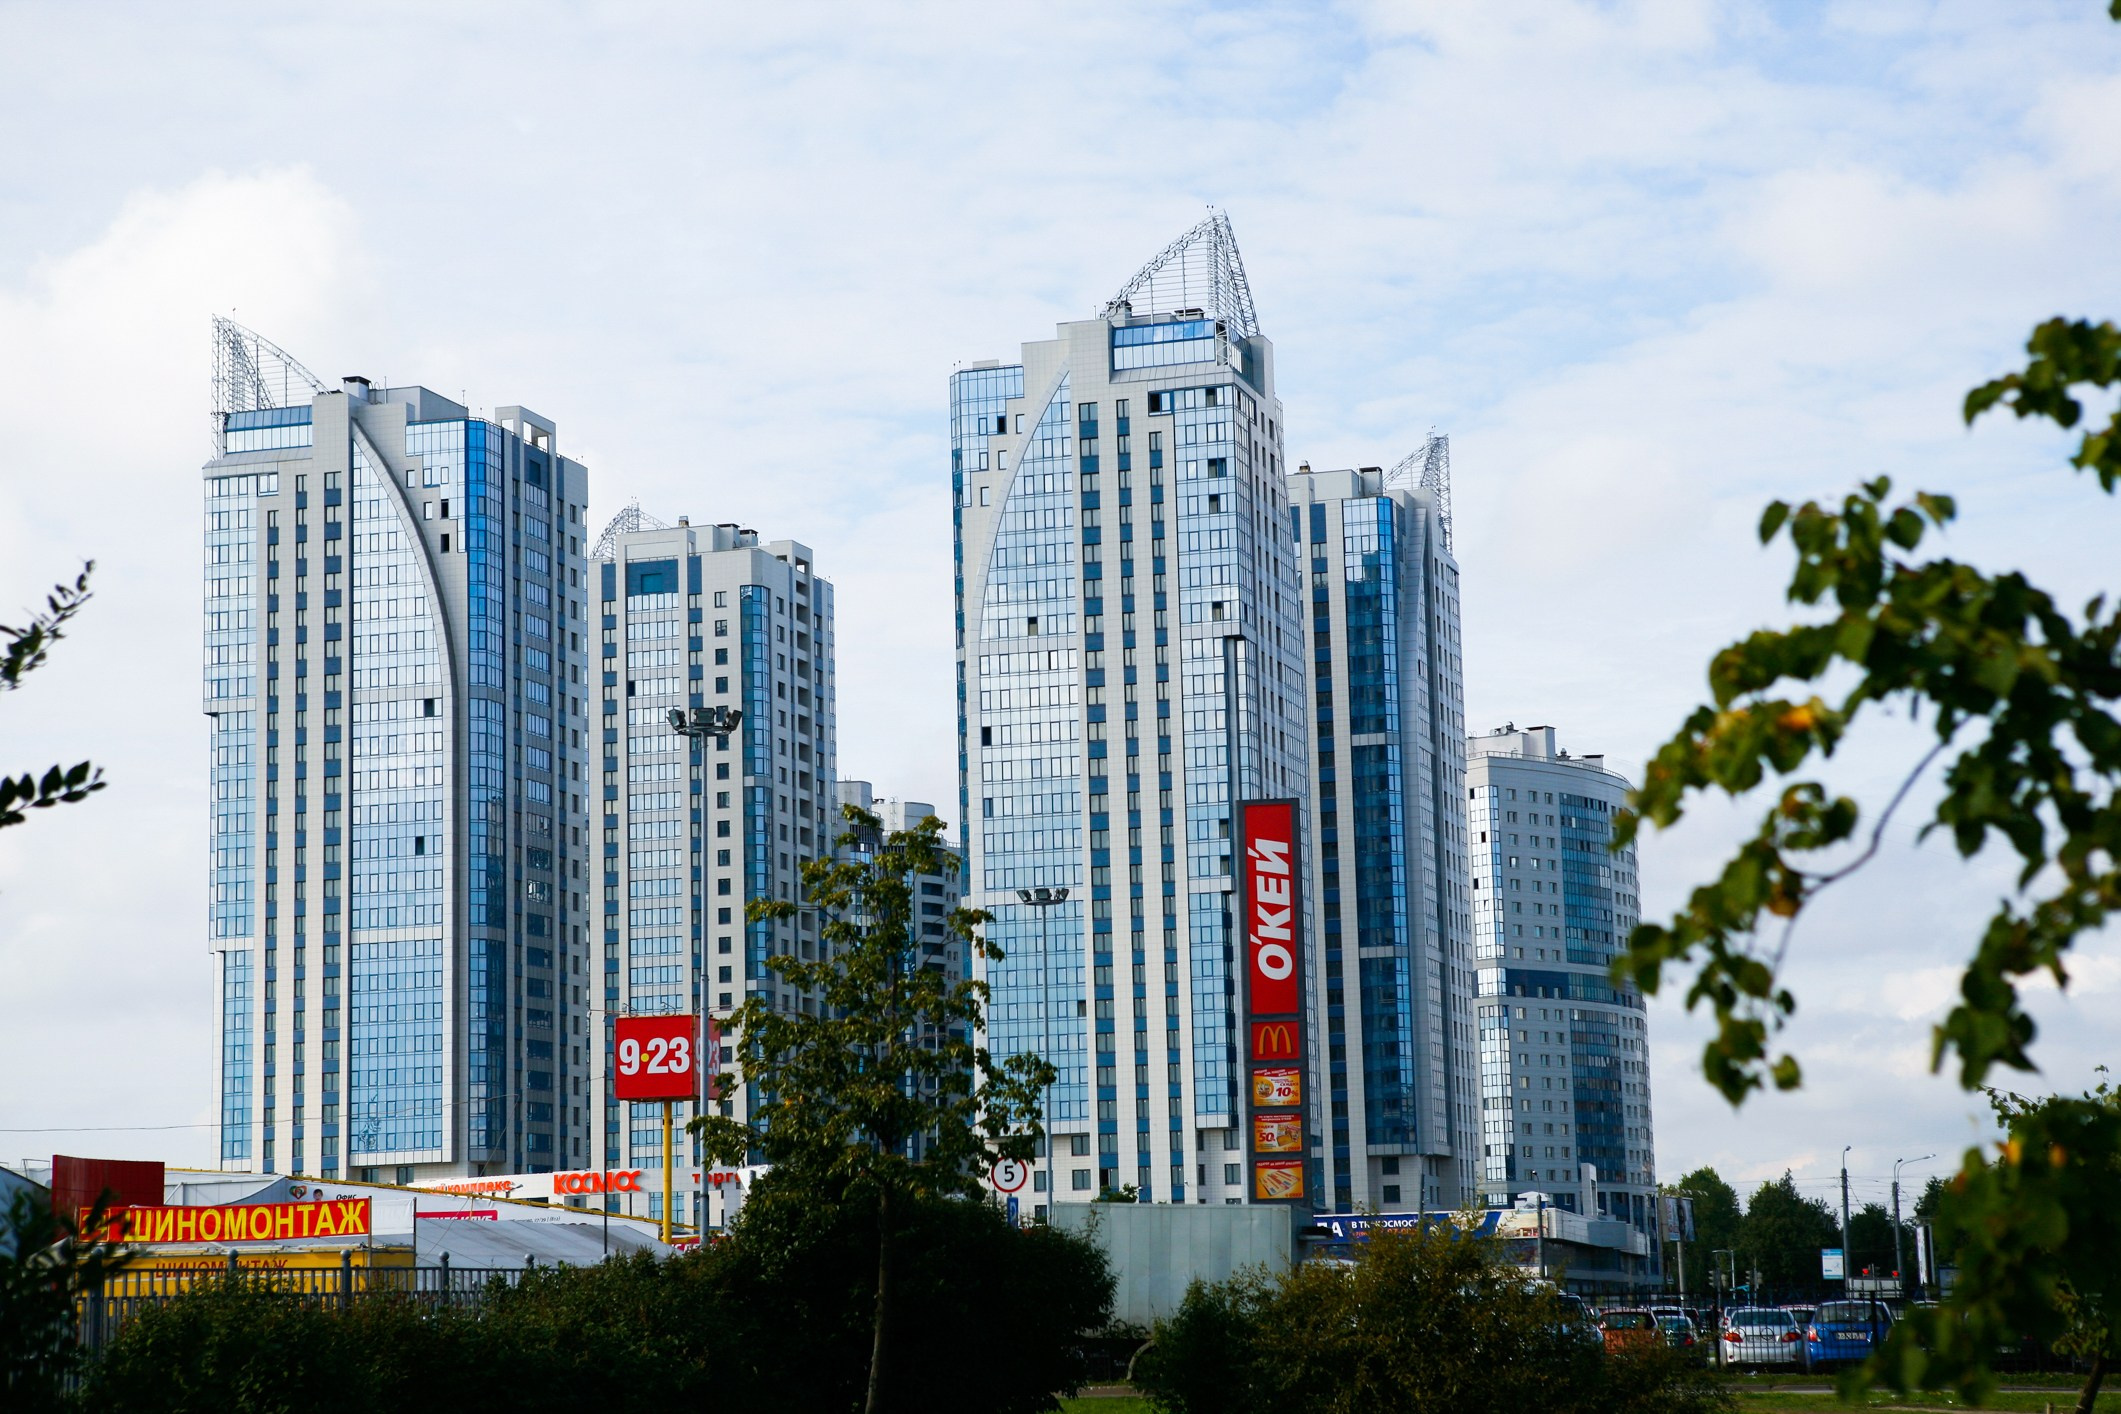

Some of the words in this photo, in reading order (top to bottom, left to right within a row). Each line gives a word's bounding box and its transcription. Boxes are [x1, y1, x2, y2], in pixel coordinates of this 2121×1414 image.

[1275, 1086, 1299, 1098] 10%
[553, 1170, 641, 1195] КОСМОС
[1004, 1165, 1015, 1183] 5
[124, 1200, 366, 1242] ШИНОМОНТАЖ
[156, 1259, 289, 1278] ШИНОМНТАЖ
